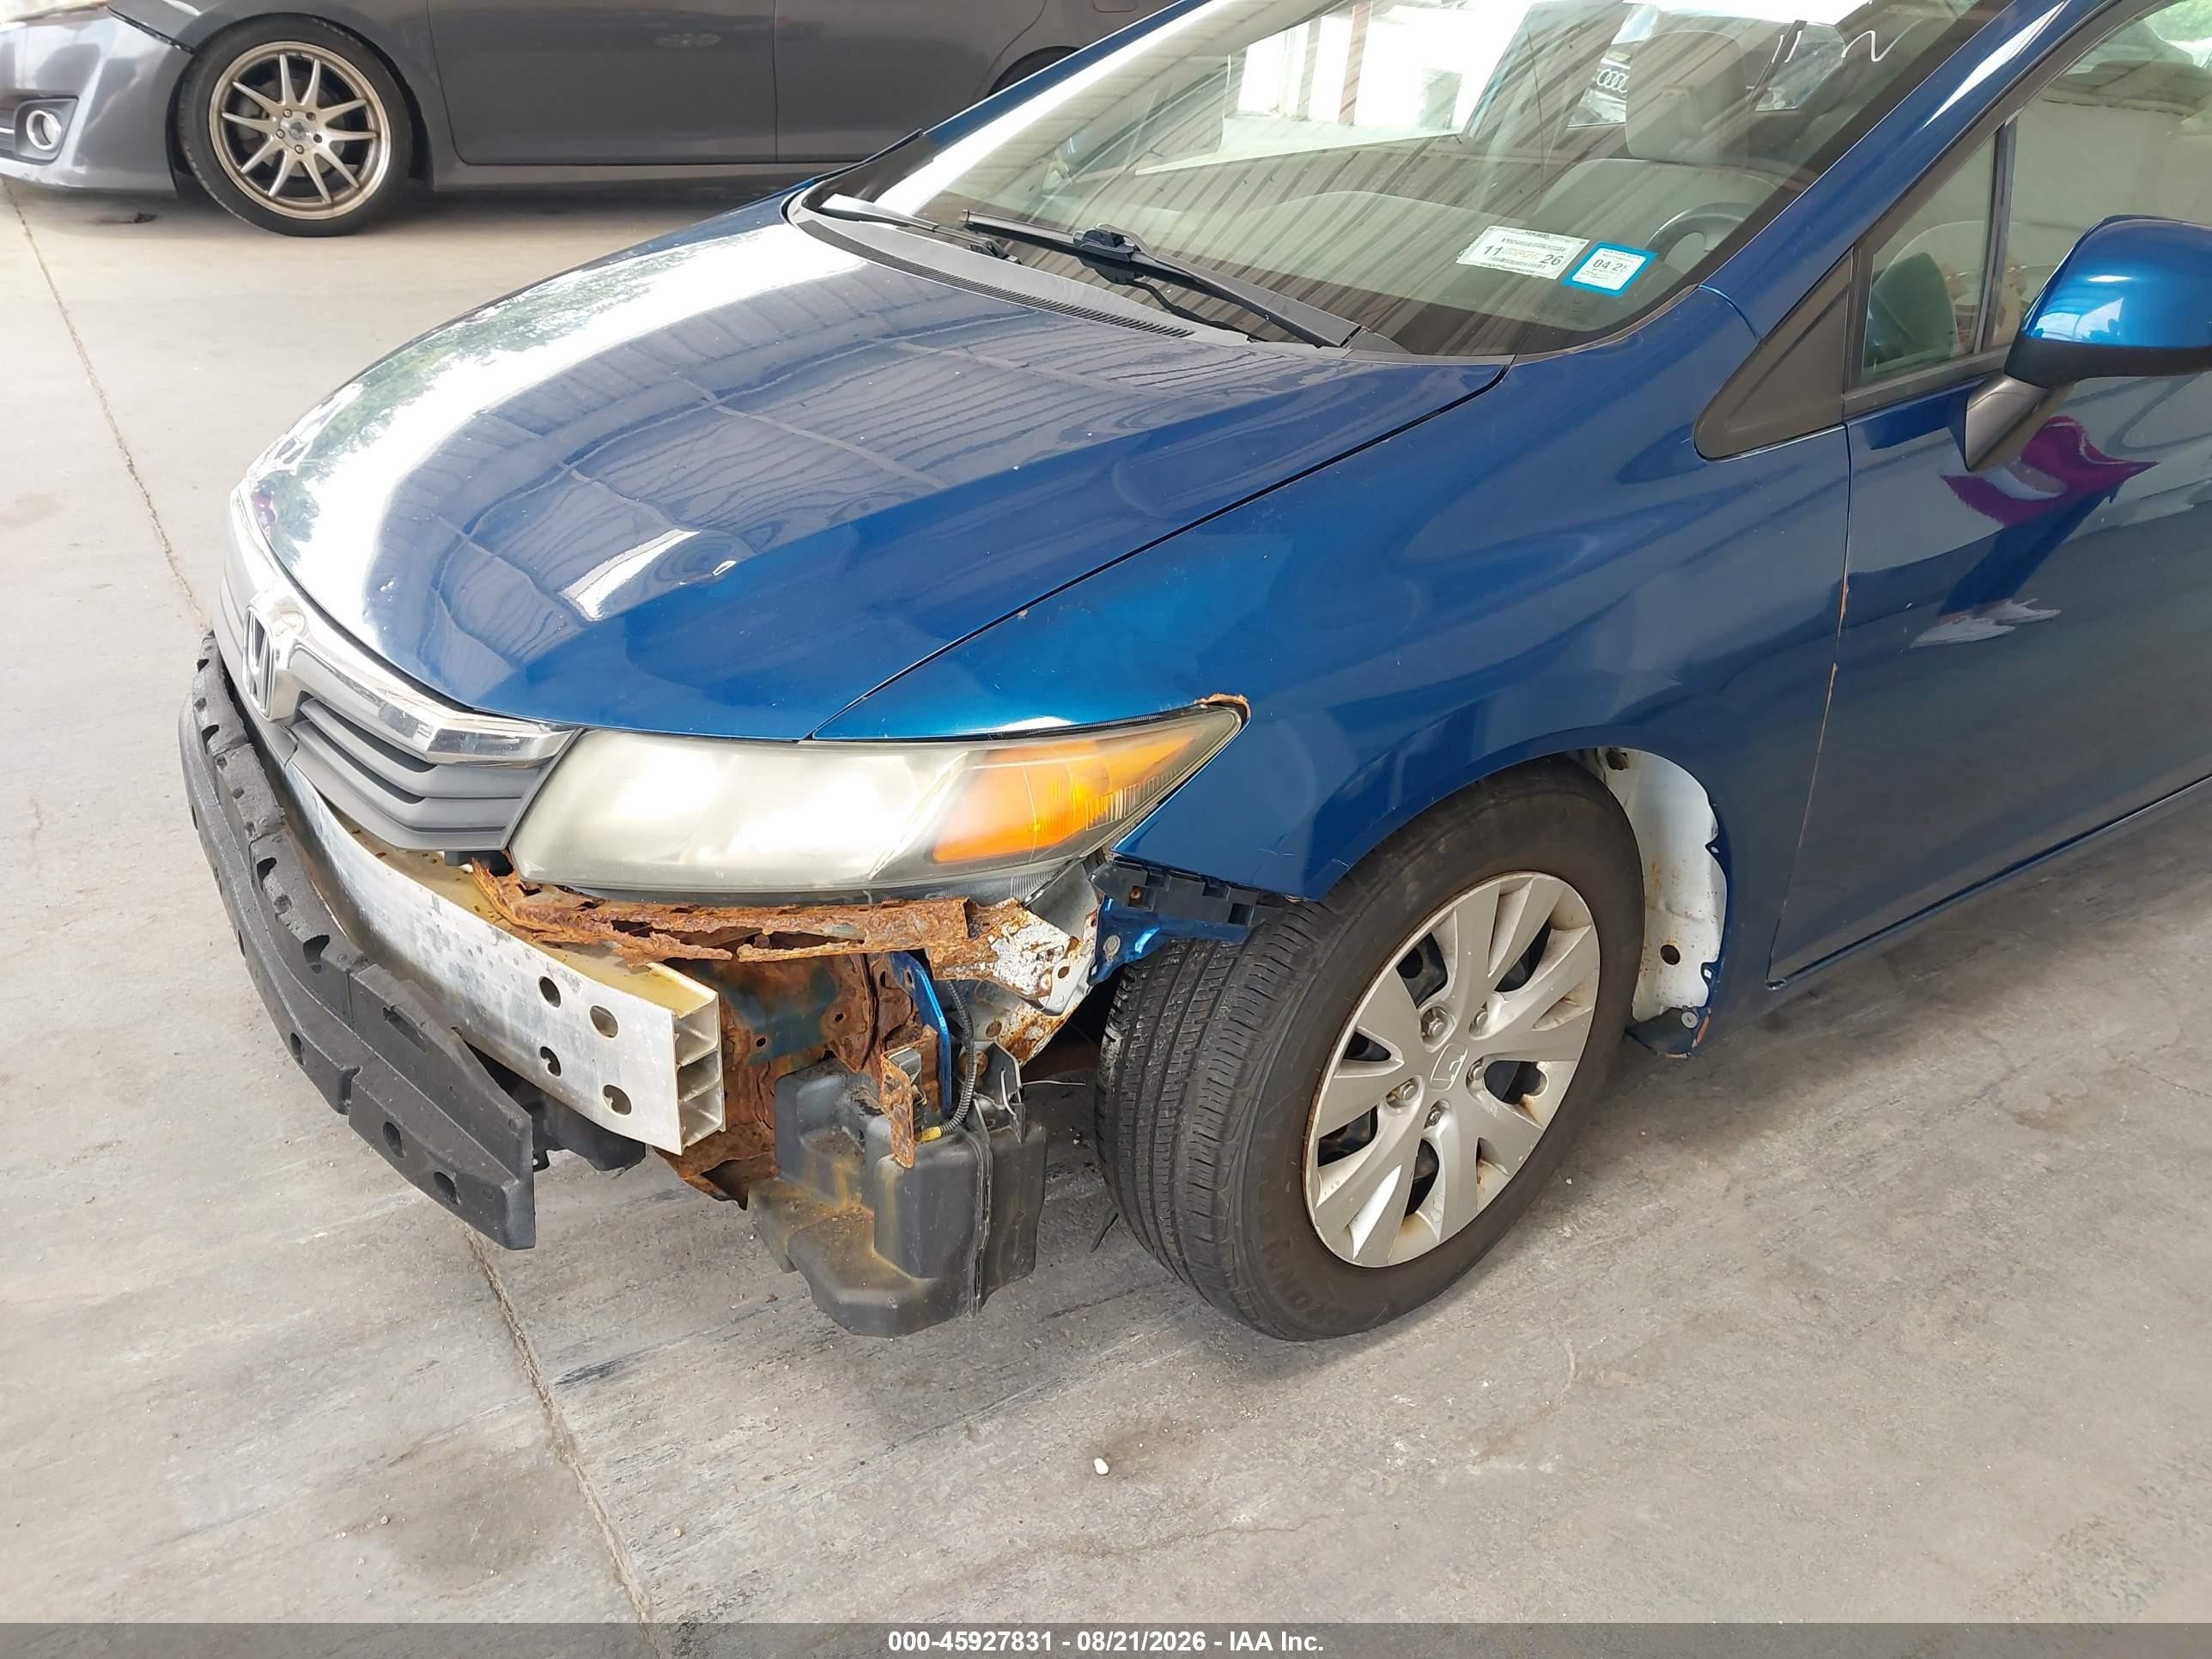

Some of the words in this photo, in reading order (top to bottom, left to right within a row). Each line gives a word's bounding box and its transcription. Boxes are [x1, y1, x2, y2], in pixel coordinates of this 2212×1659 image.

[1483, 244, 1504, 257] 11
[1539, 253, 1565, 266] 26
[1593, 258, 1611, 270] 04
